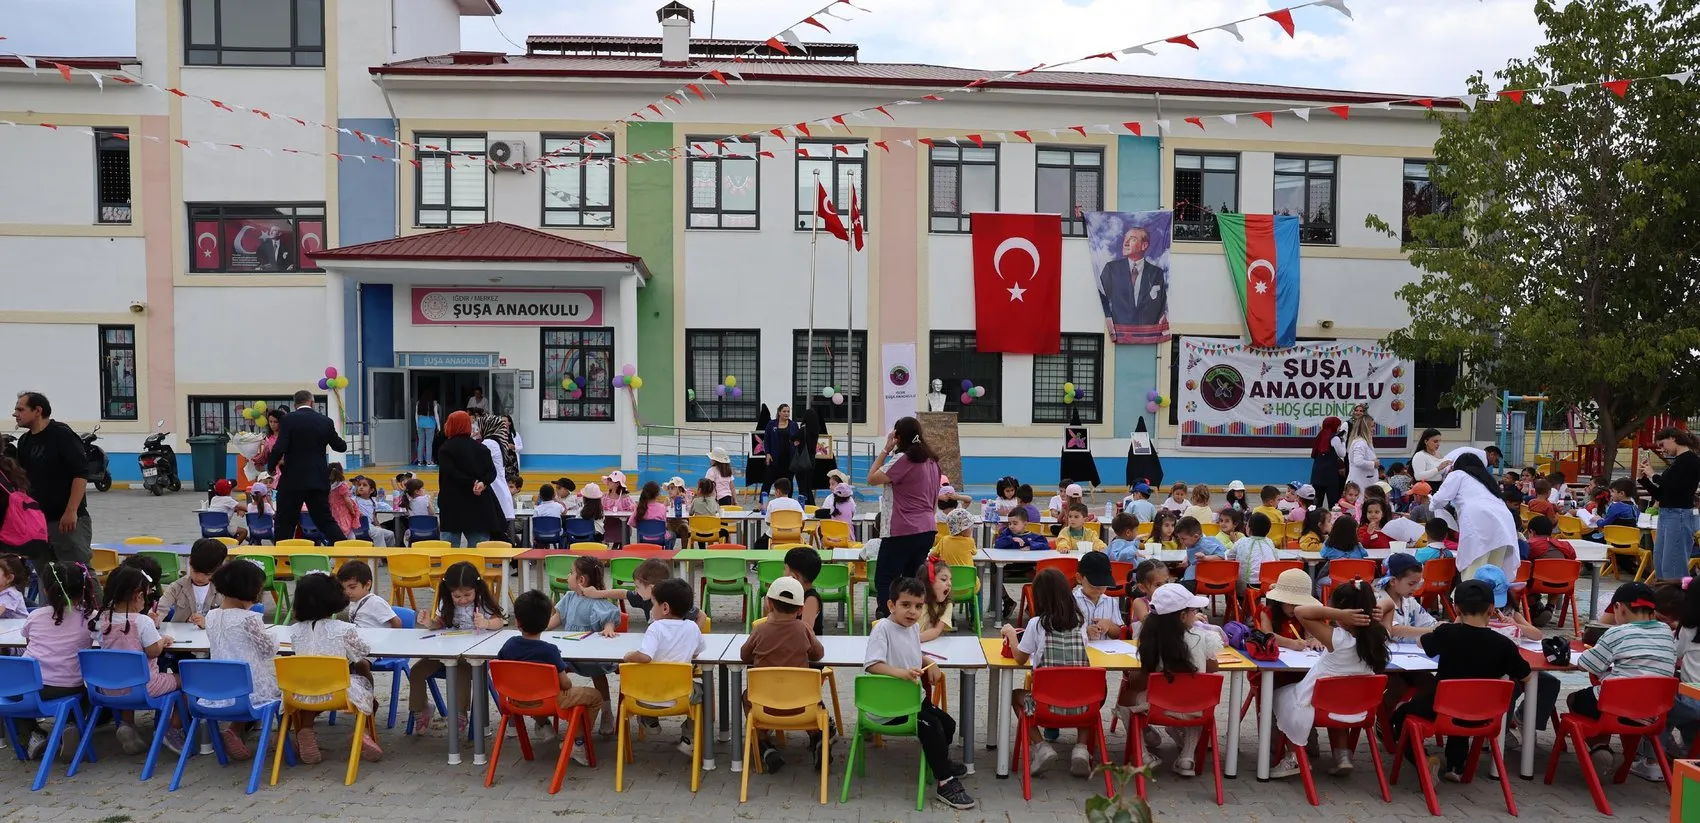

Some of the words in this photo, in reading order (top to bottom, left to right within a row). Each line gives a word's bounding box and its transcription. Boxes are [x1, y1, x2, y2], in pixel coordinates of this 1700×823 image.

[452, 294, 470, 302] IĞDIR
[453, 303, 492, 319] ŞUŞA
[495, 303, 579, 316] ANAOKULU
[423, 357, 443, 366] ŞUŞA
[445, 357, 487, 365] ANAOKULU
[1283, 358, 1353, 380] ŞUŞA
[1249, 381, 1384, 399] ANAOKULU
[1275, 402, 1300, 420] HOŞ
[1303, 400, 1356, 418] GELDİNİZ
